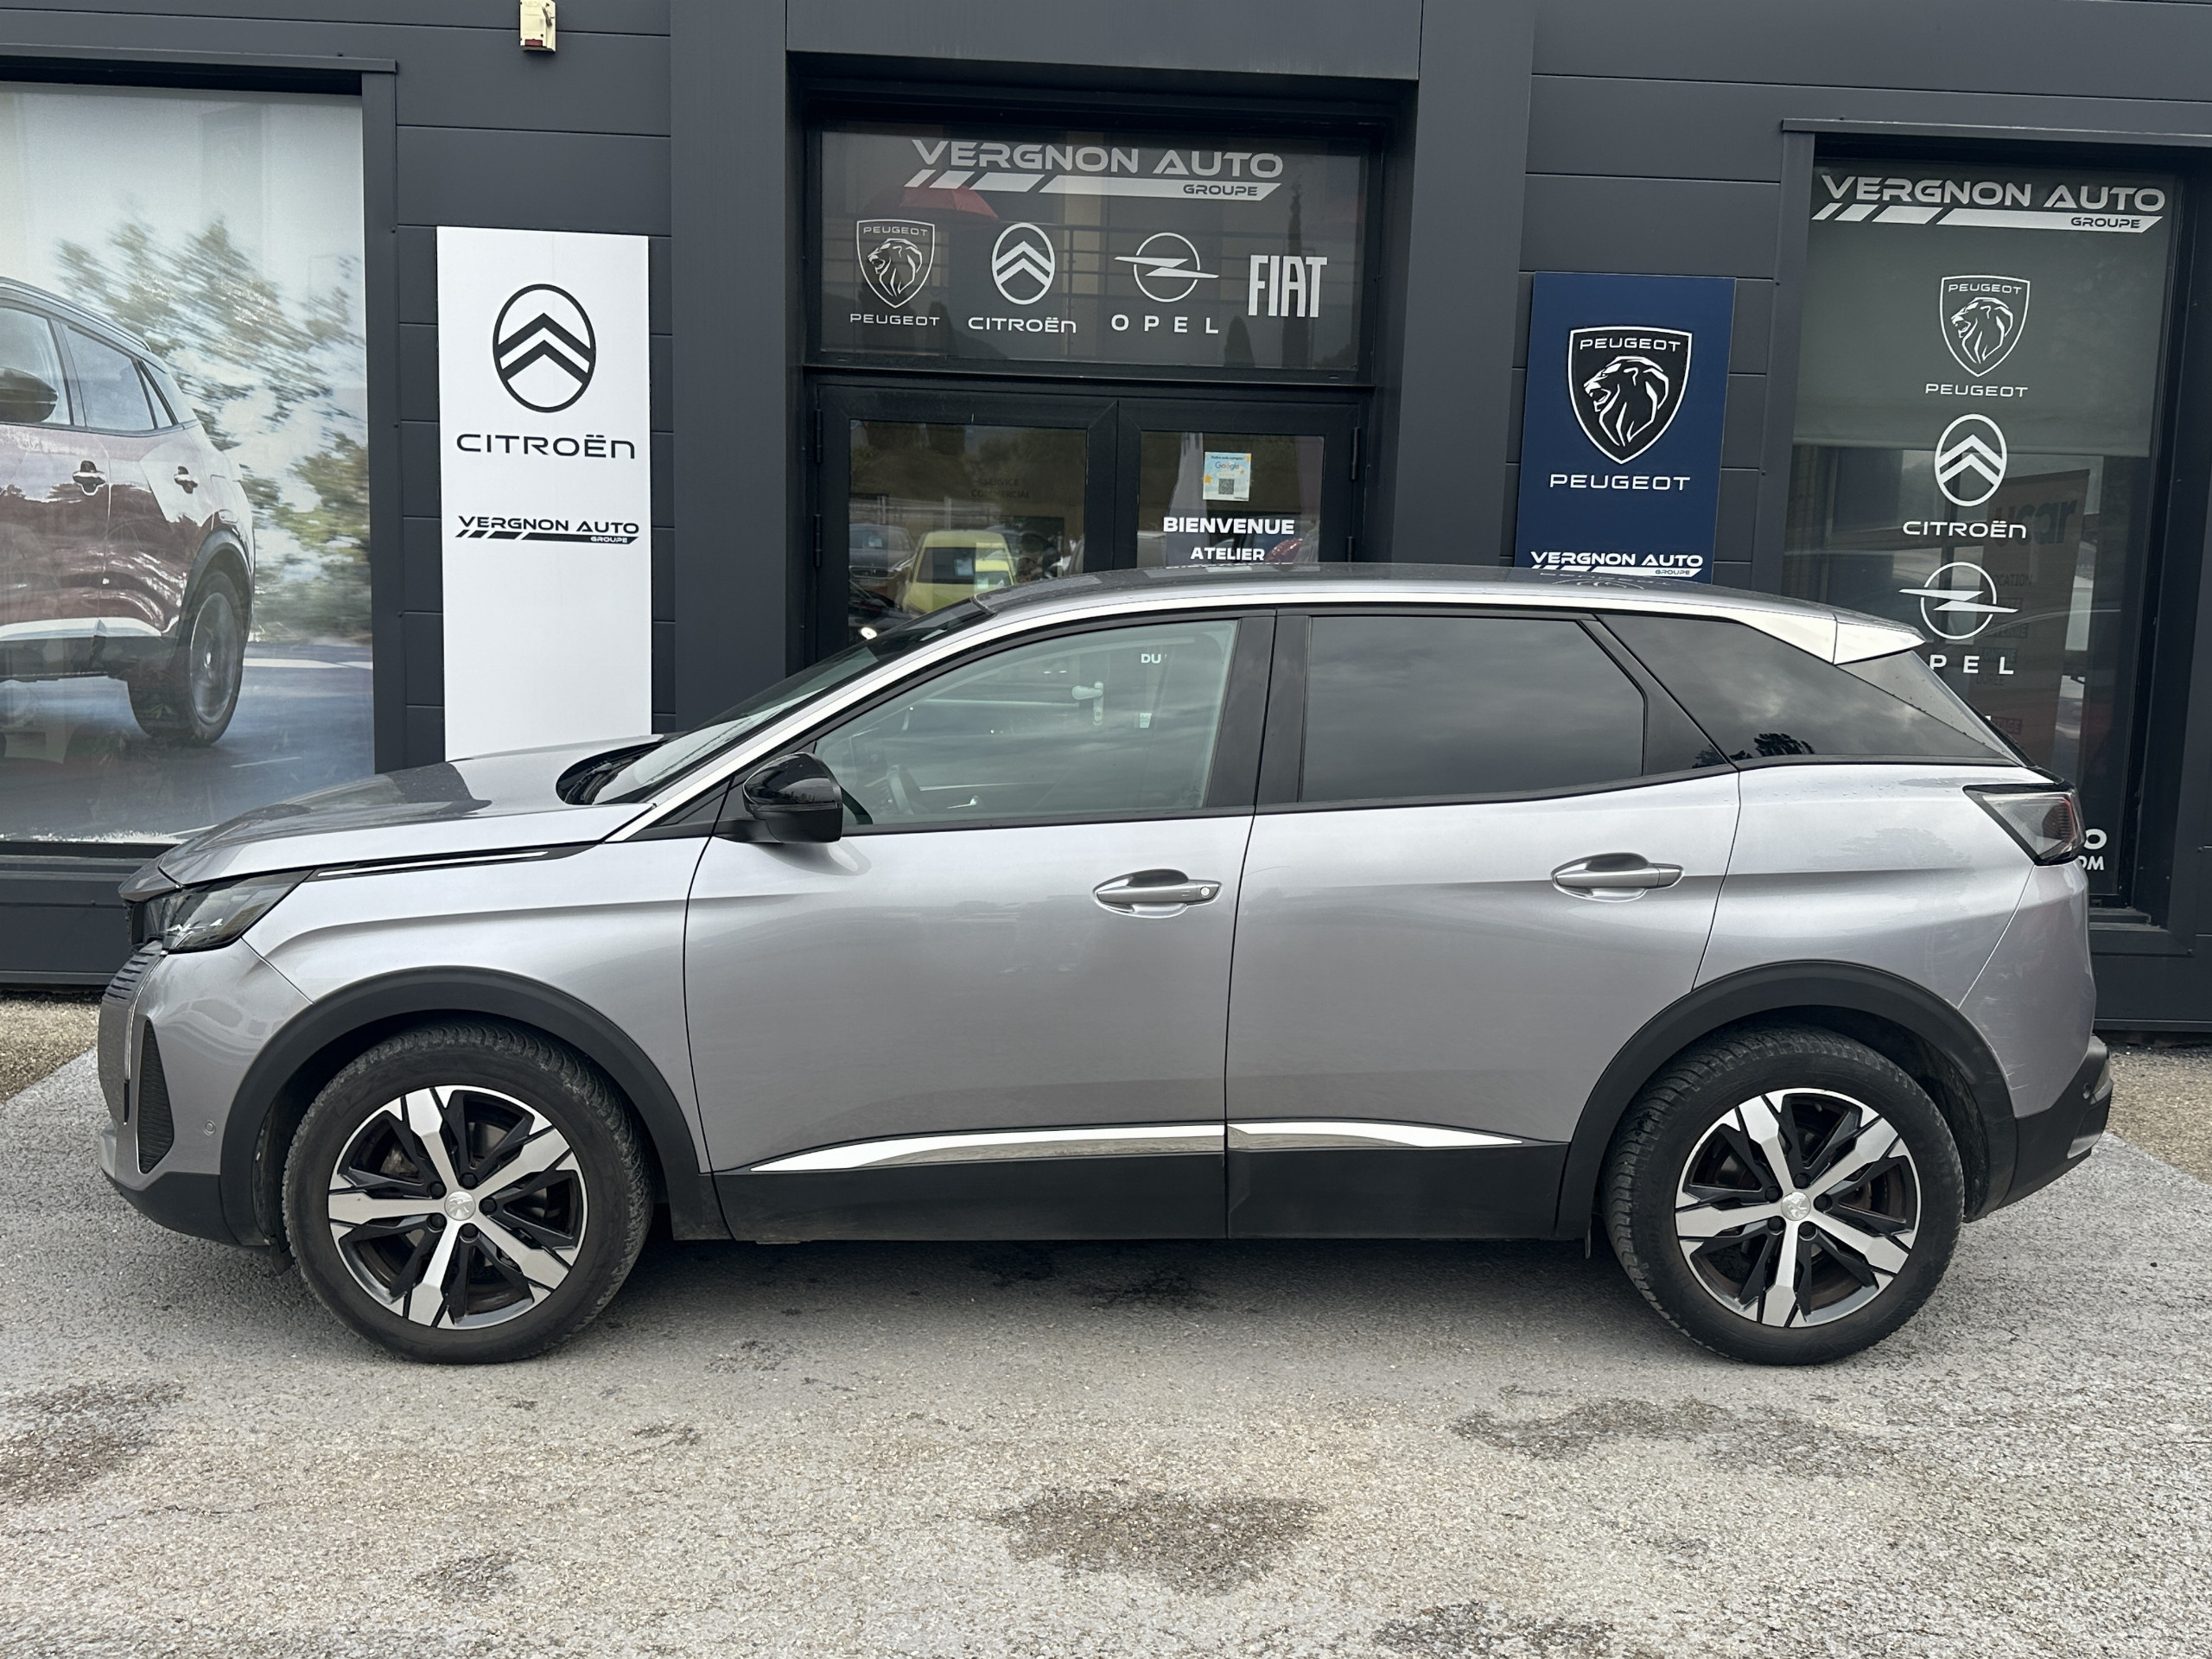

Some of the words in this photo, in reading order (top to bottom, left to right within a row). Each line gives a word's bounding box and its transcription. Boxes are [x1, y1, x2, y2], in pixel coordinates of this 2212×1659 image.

[912, 138, 1138, 175] VERGNON
[1153, 149, 1284, 178] AUTO
[1183, 184, 1258, 197] GROUPE
[1821, 175, 2032, 207] VERGNON
[2044, 184, 2165, 213] AUTO
[2070, 217, 2141, 229] GROUPE
[863, 226, 928, 237] PEUGEOT
[1248, 254, 1328, 318] FIAT
[1948, 283, 2022, 296] PEUGEOT
[850, 313, 940, 327] PEUGEOT
[1580, 337, 1681, 352] PEUGEOT
[1925, 383, 2028, 397] PEUGEOT
[1215, 461, 1240, 471] Google
[1550, 474, 1691, 491] PEUGEOT
[459, 516, 569, 532] VERGNON
[575, 520, 639, 535] AUTO
[1163, 517, 1295, 535] BIENVENUE
[1190, 547, 1265, 562] ATELIER
[1530, 551, 1637, 566] VERGNON
[1641, 554, 1704, 568] AUTO
[1928, 654, 2014, 675] PEL
